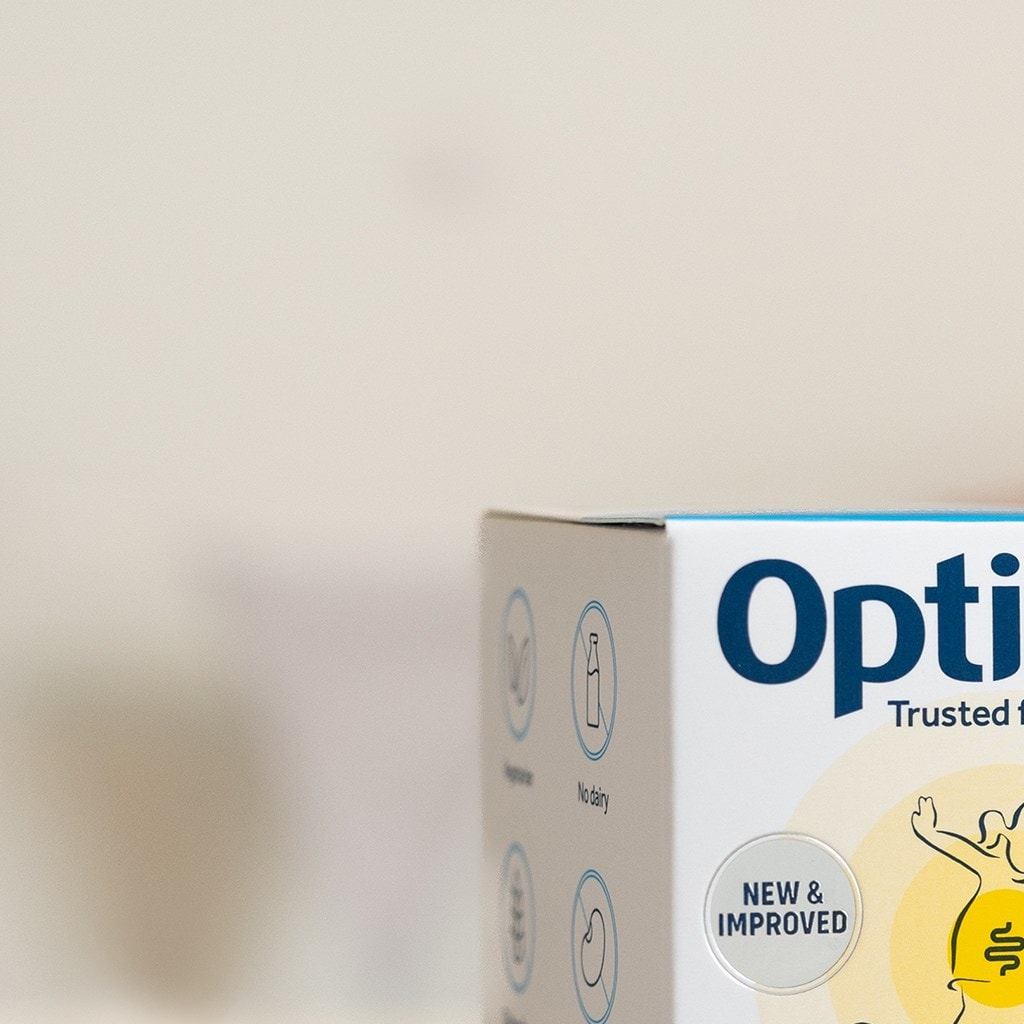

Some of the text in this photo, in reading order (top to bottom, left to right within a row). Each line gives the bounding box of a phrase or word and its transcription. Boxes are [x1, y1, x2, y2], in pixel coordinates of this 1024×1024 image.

[888, 700, 1009, 727] Trusted
[578, 781, 609, 814] No dairy
[743, 880, 823, 906] NEW &
[718, 910, 847, 936] IMPROVED
